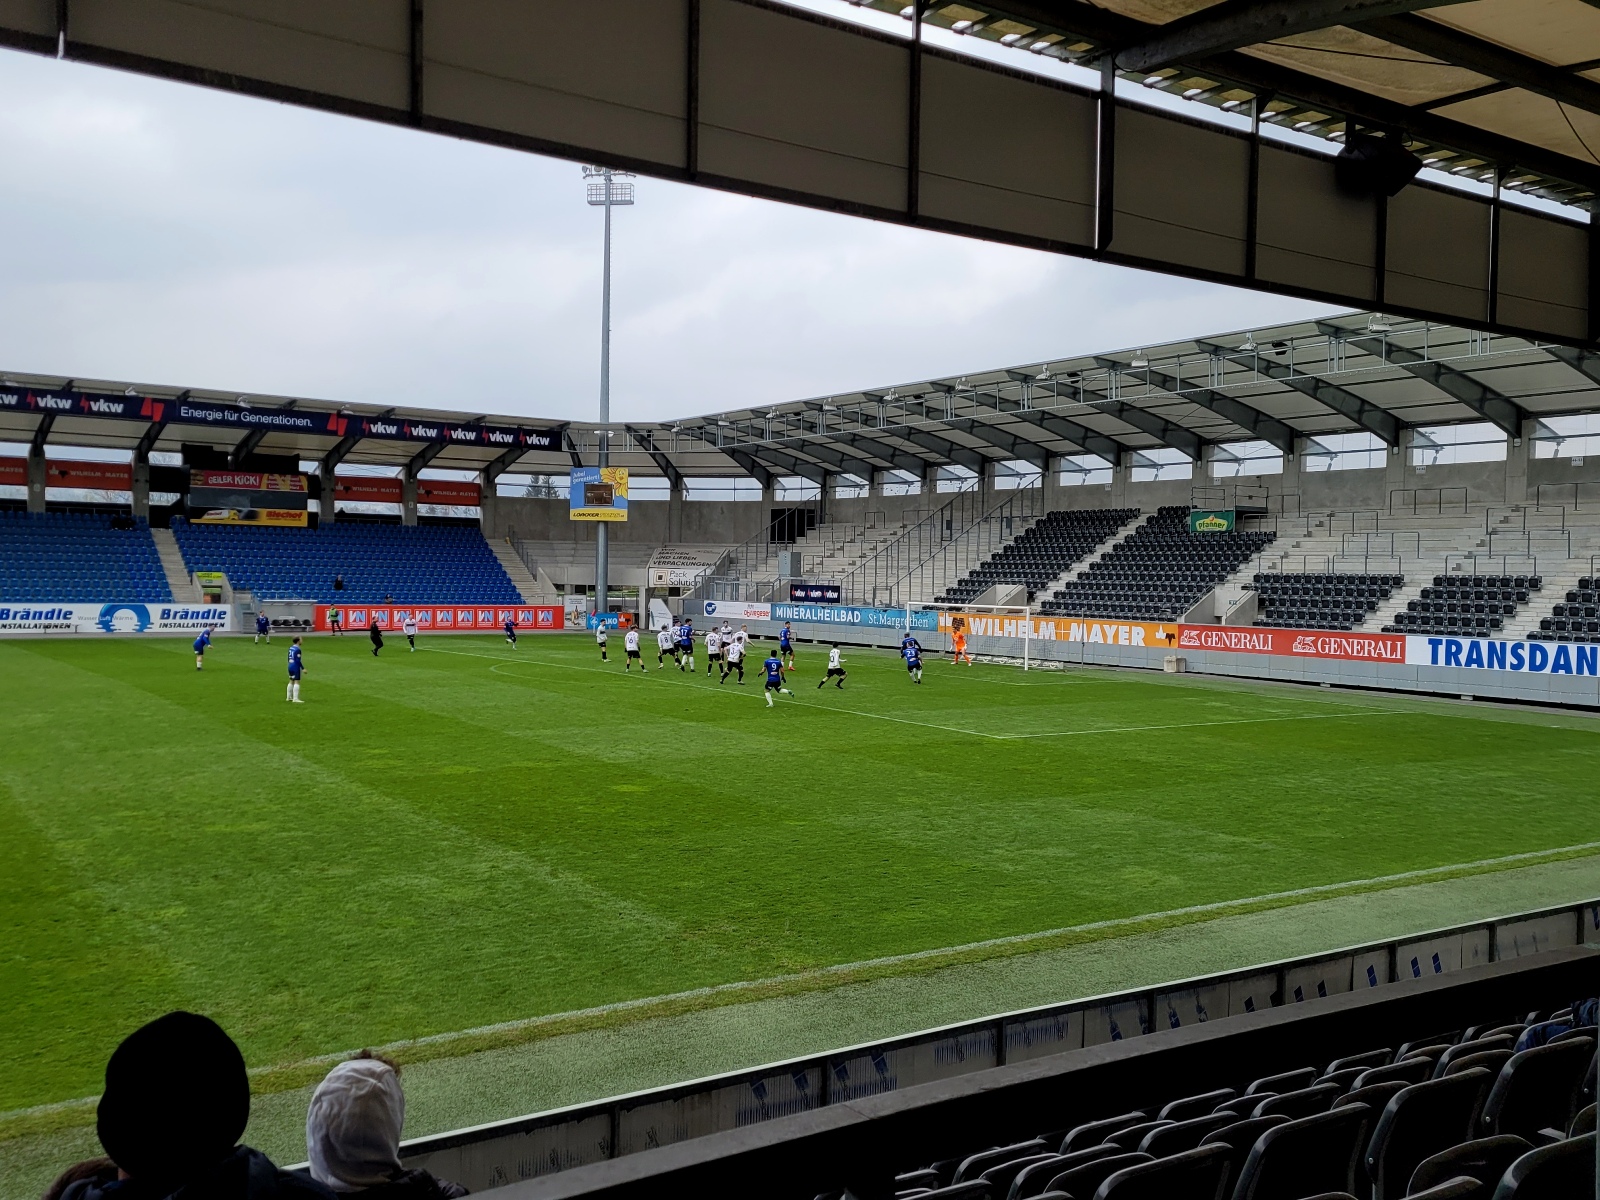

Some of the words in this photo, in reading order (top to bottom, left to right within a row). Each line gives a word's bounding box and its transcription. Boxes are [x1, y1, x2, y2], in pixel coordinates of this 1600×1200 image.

[36, 394, 72, 410] vkw
[90, 399, 124, 414] vkw
[180, 406, 222, 421] Energie
[224, 410, 239, 421] für
[240, 412, 313, 427] Generationen.
[370, 420, 398, 434] vkw
[411, 424, 437, 438] vkw
[450, 428, 476, 441] vkw
[489, 430, 514, 443] vkw
[526, 433, 550, 446] vkw
[1198, 521, 1226, 530] pfanner
[669, 570, 687, 578] Pack
[0, 608, 73, 621] Brändle
[160, 608, 227, 621] Brändle
[601, 617, 618, 625] AKO
[776, 606, 861, 623] MINERALHEILBAD
[969, 617, 1057, 641] WILHELM
[1069, 623, 1146, 647] MAYER
[709, 638, 716, 647] 12
[1201, 630, 1273, 651] GENERALI
[906, 650, 916, 658] 23
[1317, 637, 1403, 659] GENERALI
[1427, 637, 1599, 676] TRANSDAN
[771, 662, 777, 671] 9
